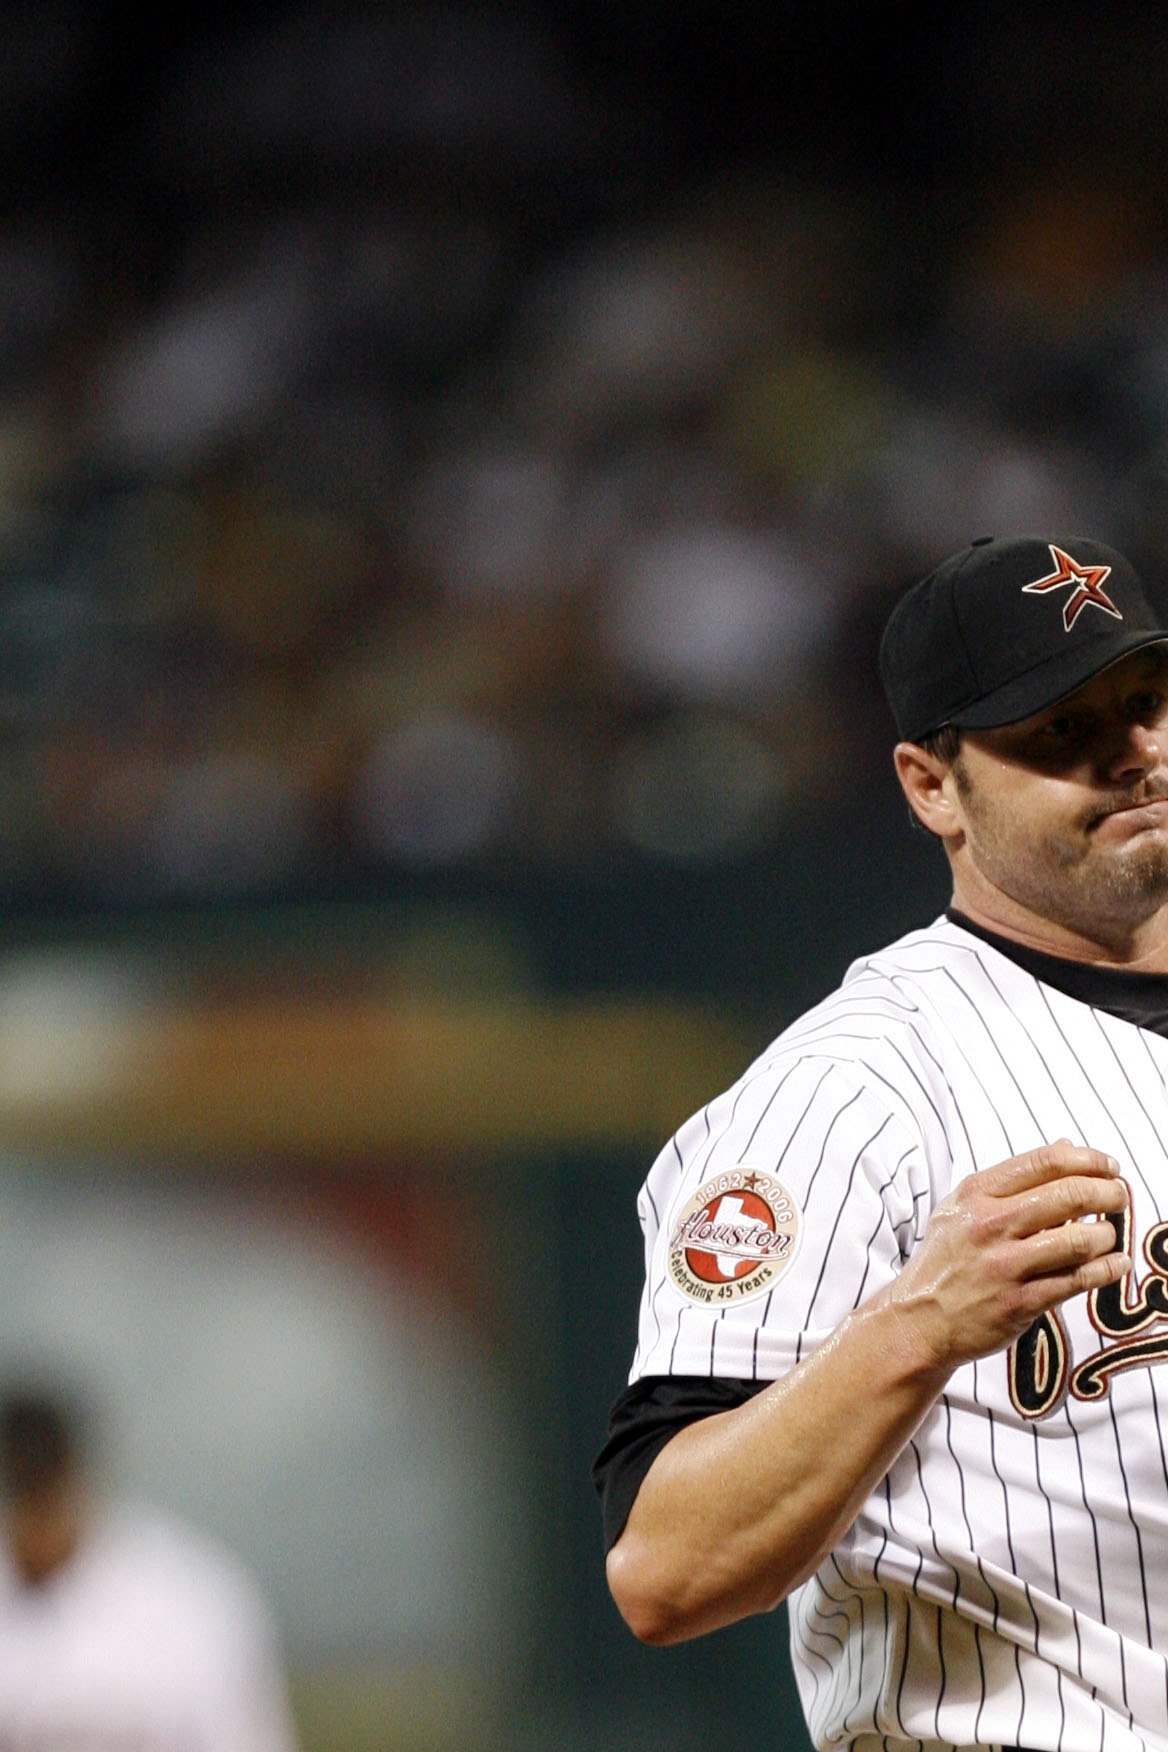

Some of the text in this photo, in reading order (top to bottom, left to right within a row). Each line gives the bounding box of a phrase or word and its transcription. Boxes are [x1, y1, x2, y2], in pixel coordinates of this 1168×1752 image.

[696, 1172, 793, 1224] 1962 2006
[670, 1208, 793, 1258] Houston
[670, 1249, 773, 1302] Celebrating 45 Years
